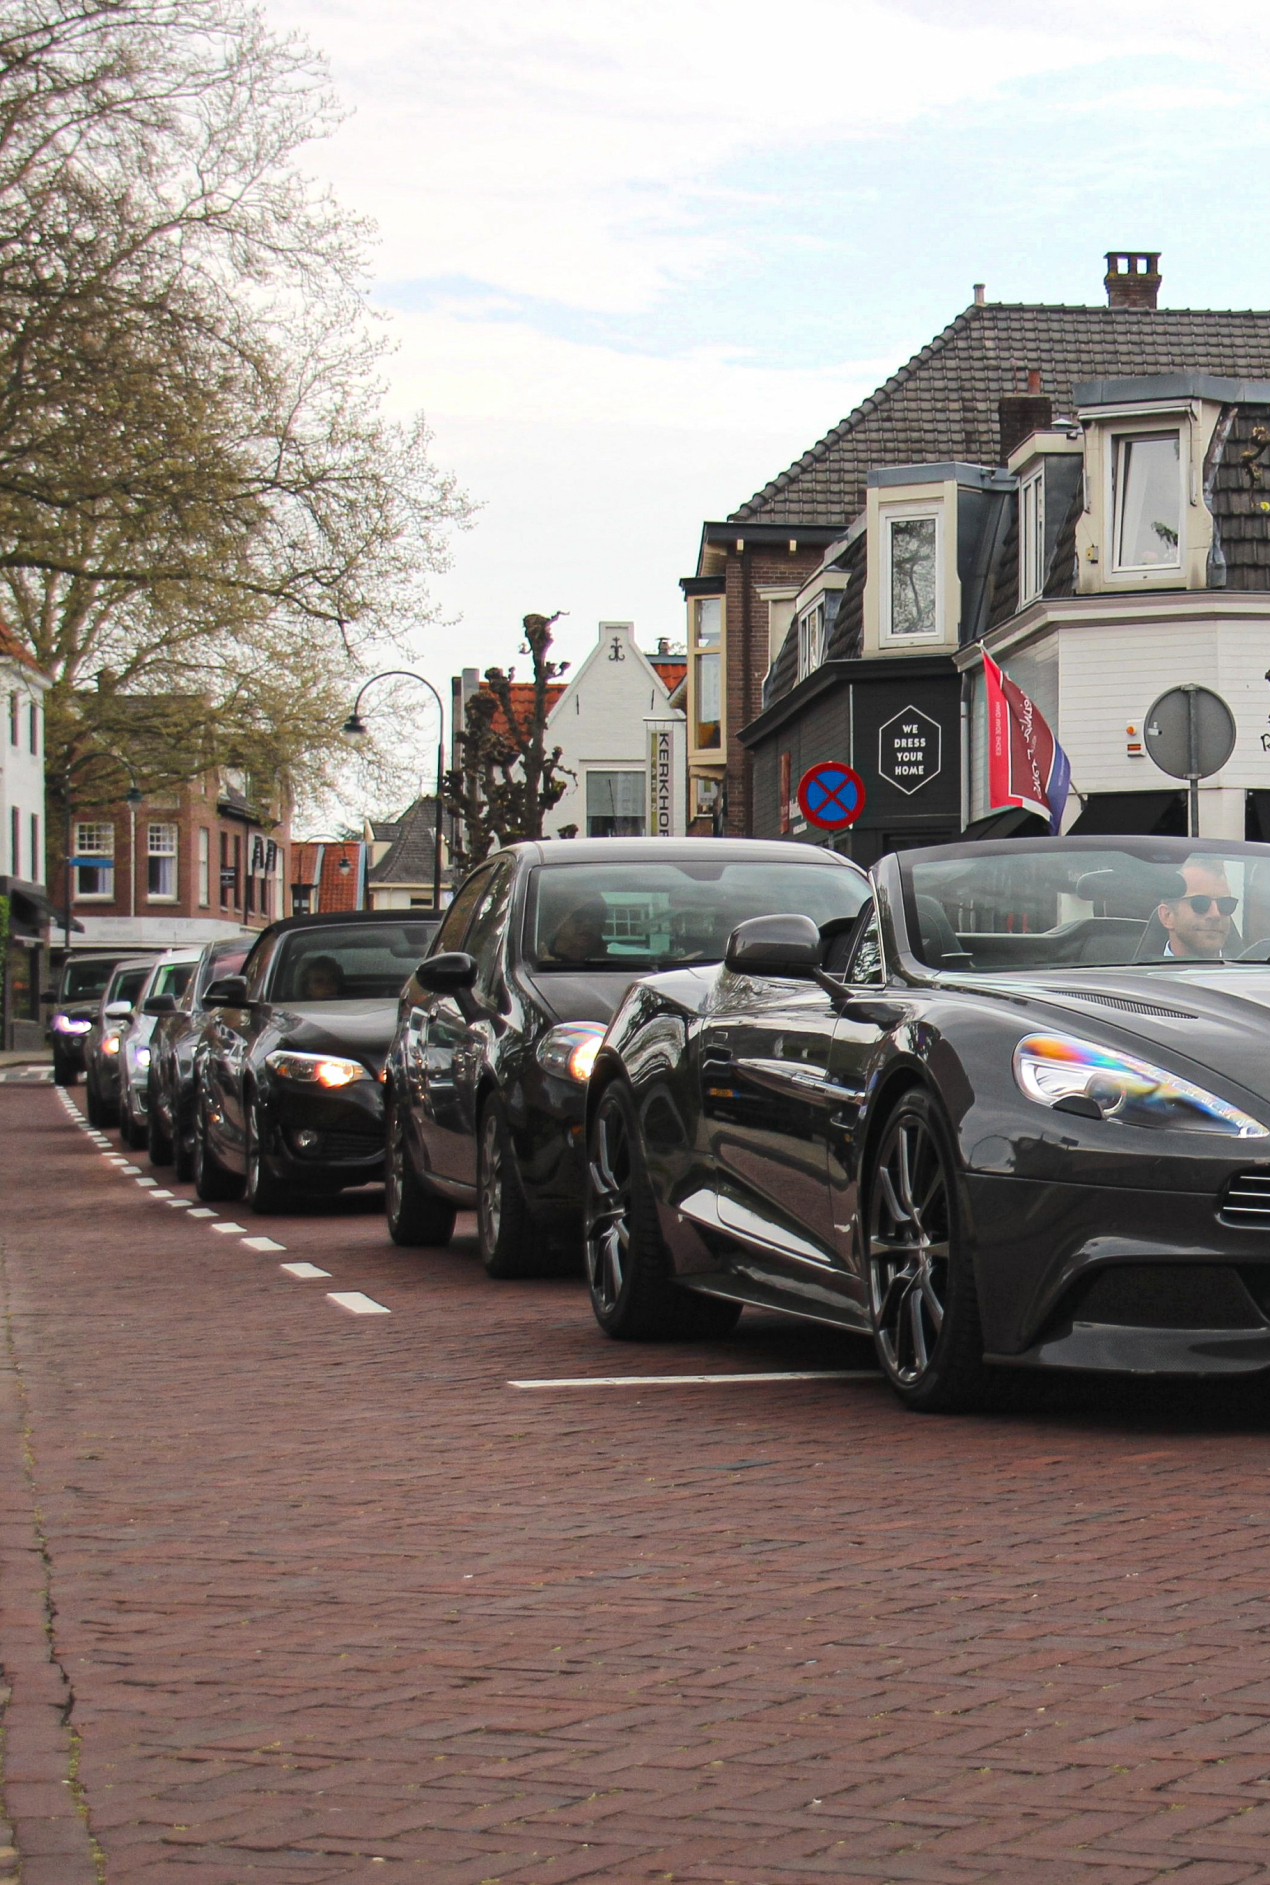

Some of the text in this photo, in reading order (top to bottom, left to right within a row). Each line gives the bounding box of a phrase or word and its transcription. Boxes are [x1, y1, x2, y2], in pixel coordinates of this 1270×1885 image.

[902, 724, 919, 734] WE
[894, 737, 927, 748] DRESS
[896, 752, 924, 762] YOUR
[894, 765, 925, 776] HOME
